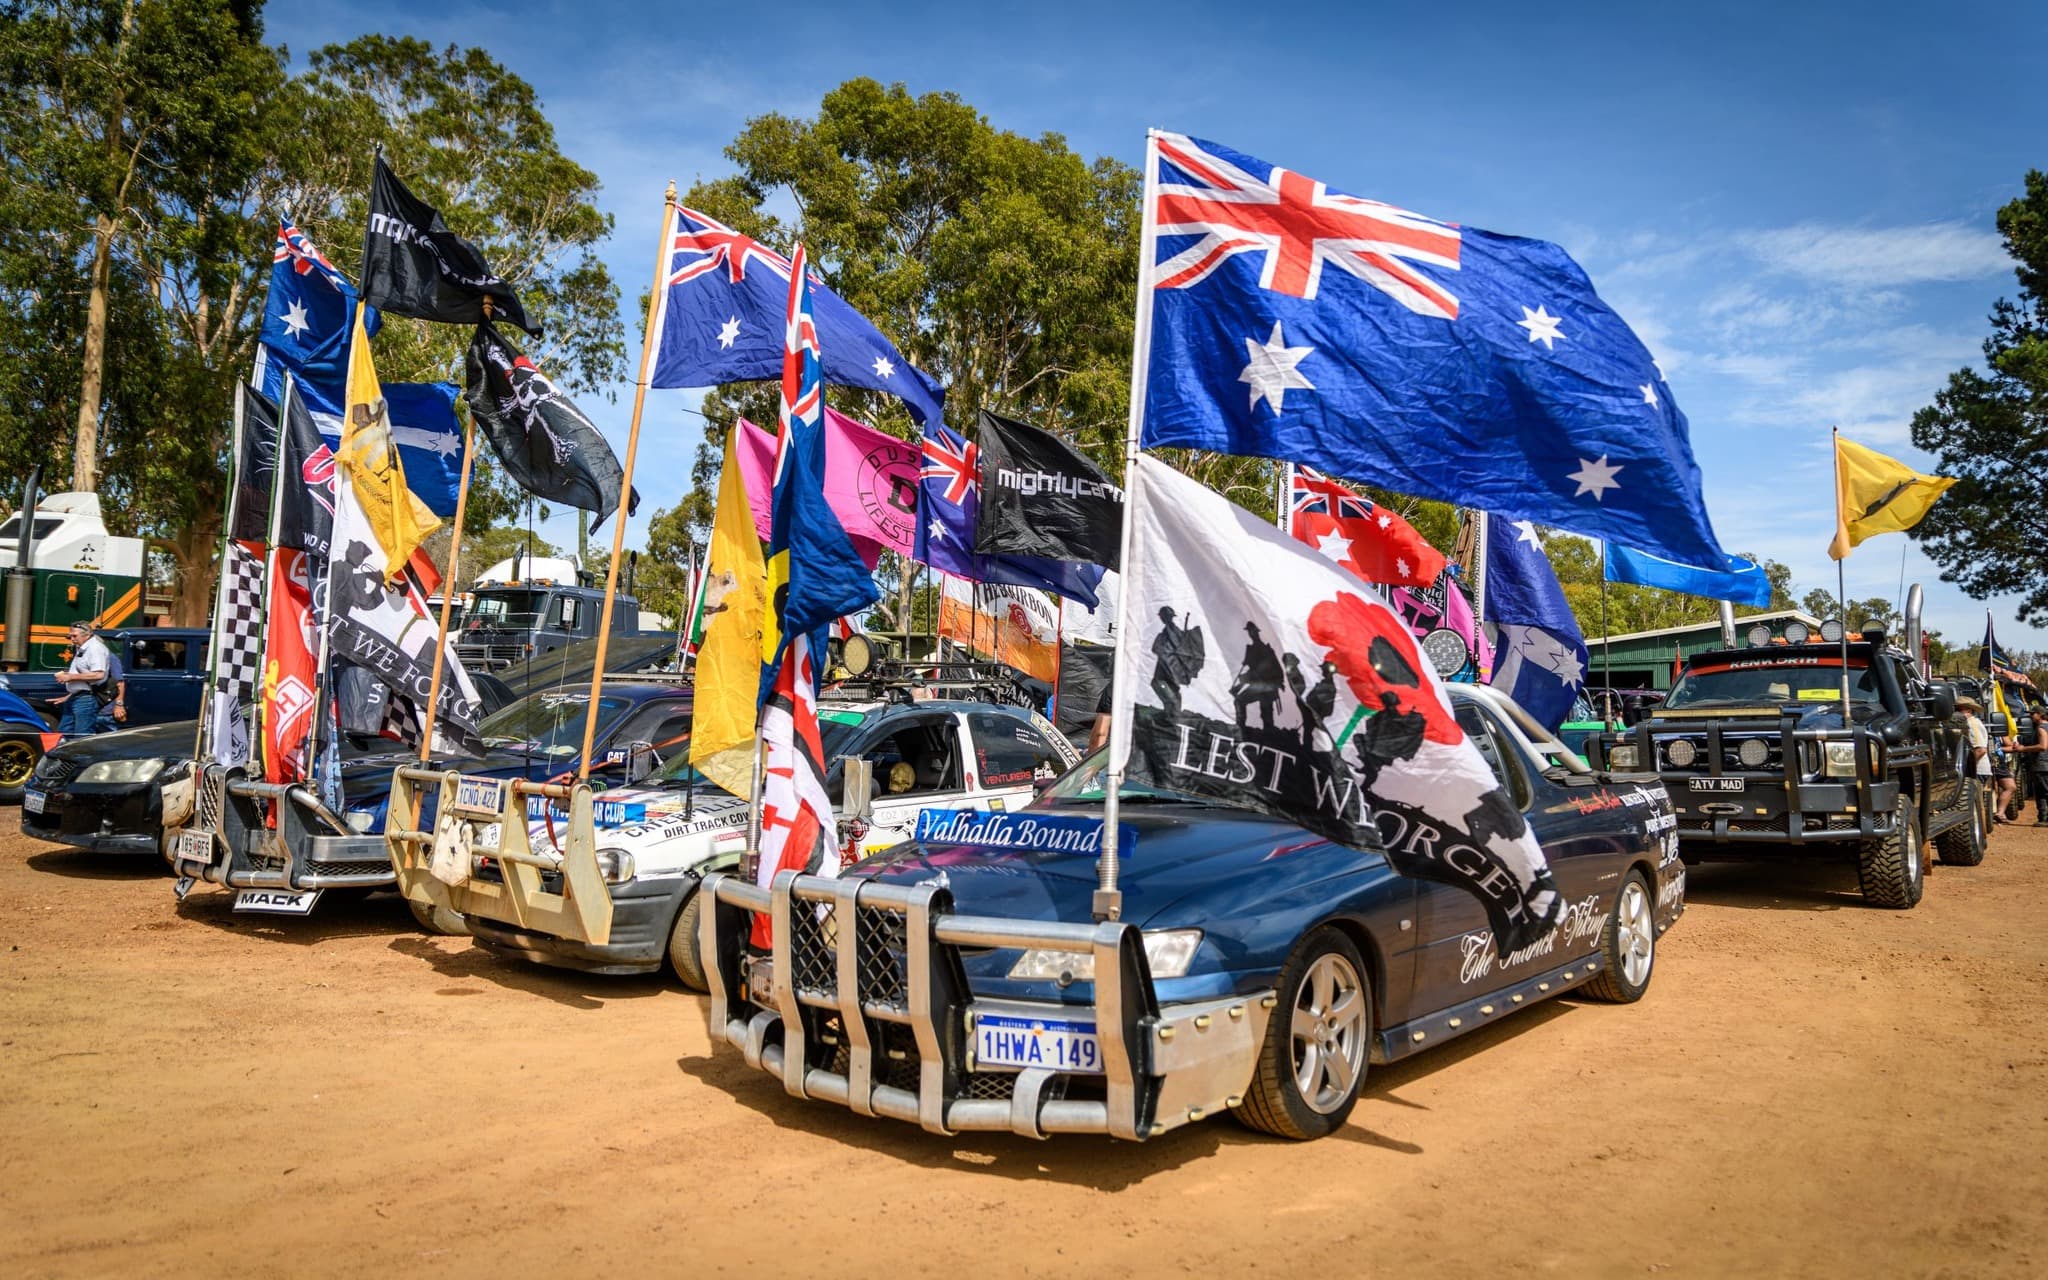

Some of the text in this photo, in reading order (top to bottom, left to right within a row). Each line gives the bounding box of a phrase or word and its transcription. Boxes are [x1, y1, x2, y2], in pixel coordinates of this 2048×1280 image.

[353, 630, 399, 673] WE
[607, 751, 625, 763] CAT
[1170, 723, 1296, 794] LEST
[1720, 780, 1742, 790] MAD
[604, 801, 626, 824] CLUB
[664, 824, 690, 839] DIRT
[694, 814, 729, 833] TRACK
[920, 809, 1104, 852] Valhalla Bound
[240, 893, 304, 907] MACK
[1460, 930, 1494, 984] The
[1563, 895, 1609, 948] Viking
